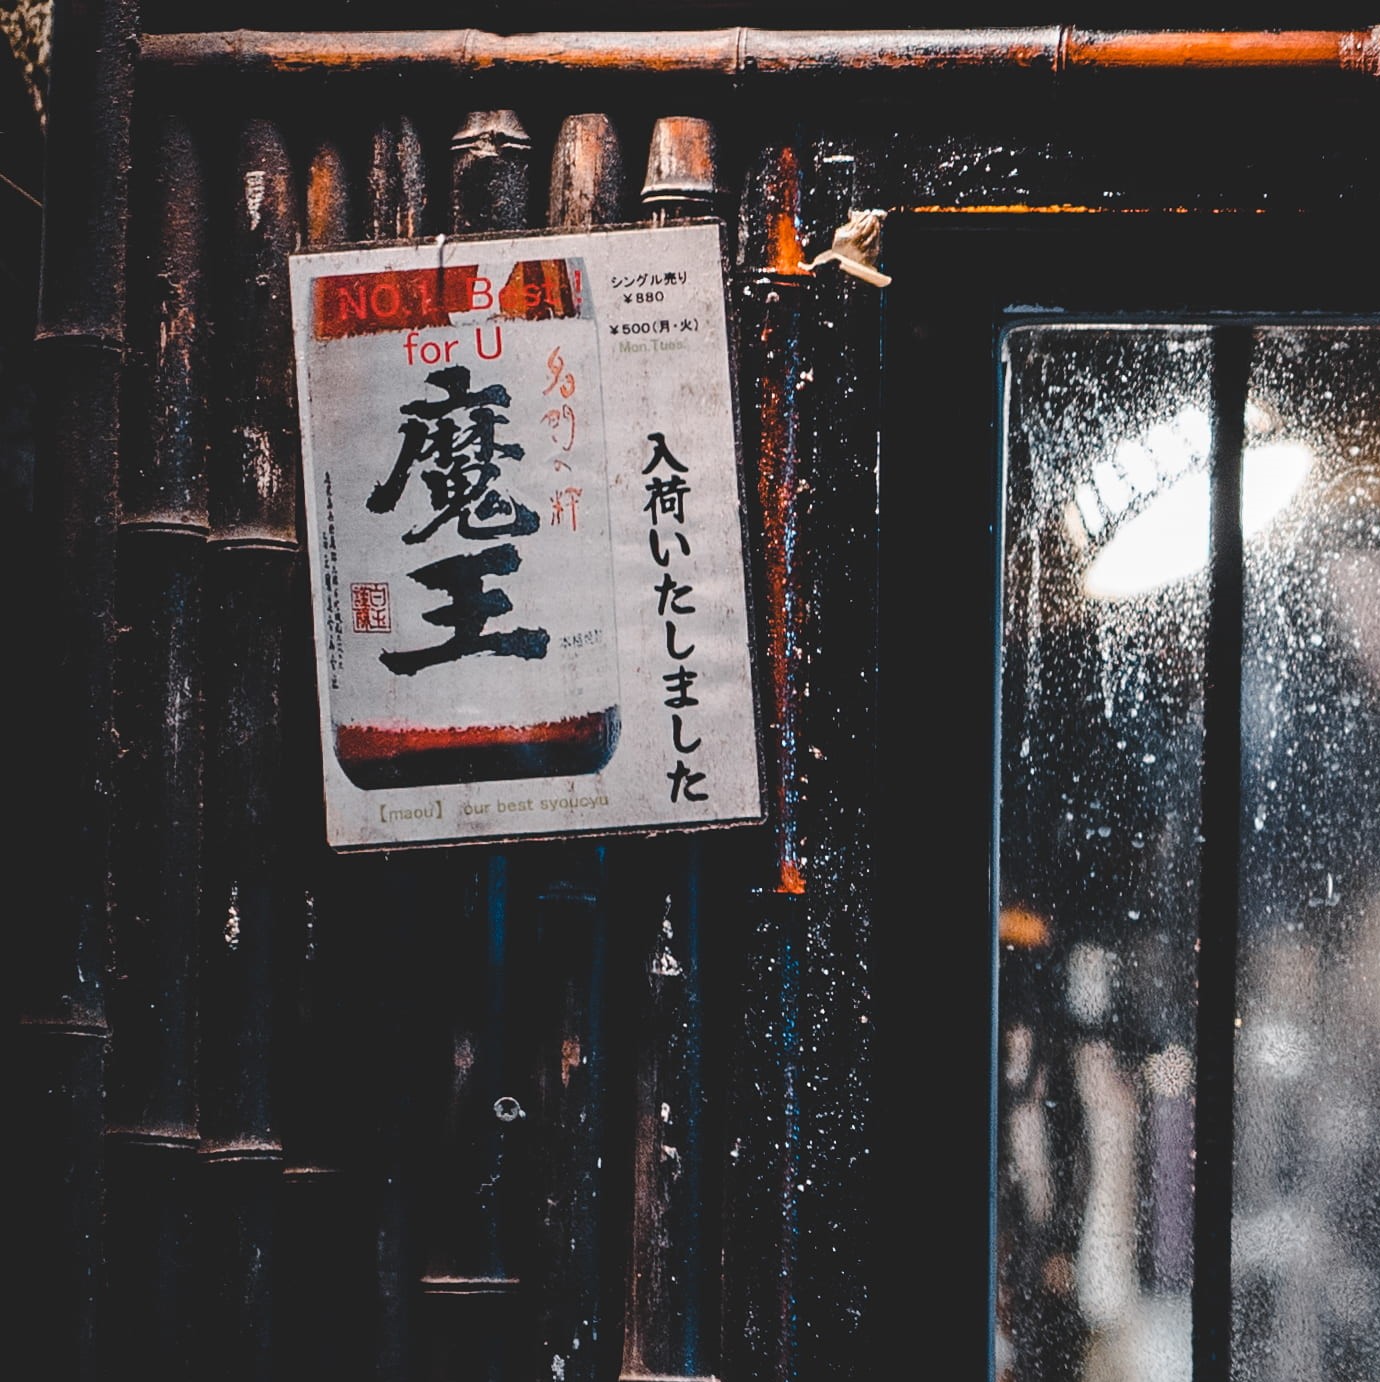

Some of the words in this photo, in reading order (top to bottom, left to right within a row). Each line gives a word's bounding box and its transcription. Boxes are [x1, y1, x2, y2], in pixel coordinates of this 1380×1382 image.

[611, 271, 687, 289] シングル売り
[623, 290, 664, 304] ¥880
[402, 332, 459, 366] for
[475, 326, 503, 361] U
[364, 364, 551, 678] 魔王
[641, 432, 709, 803] 入荷いたしました
[463, 801, 490, 816] our
[496, 799, 533, 813] best
